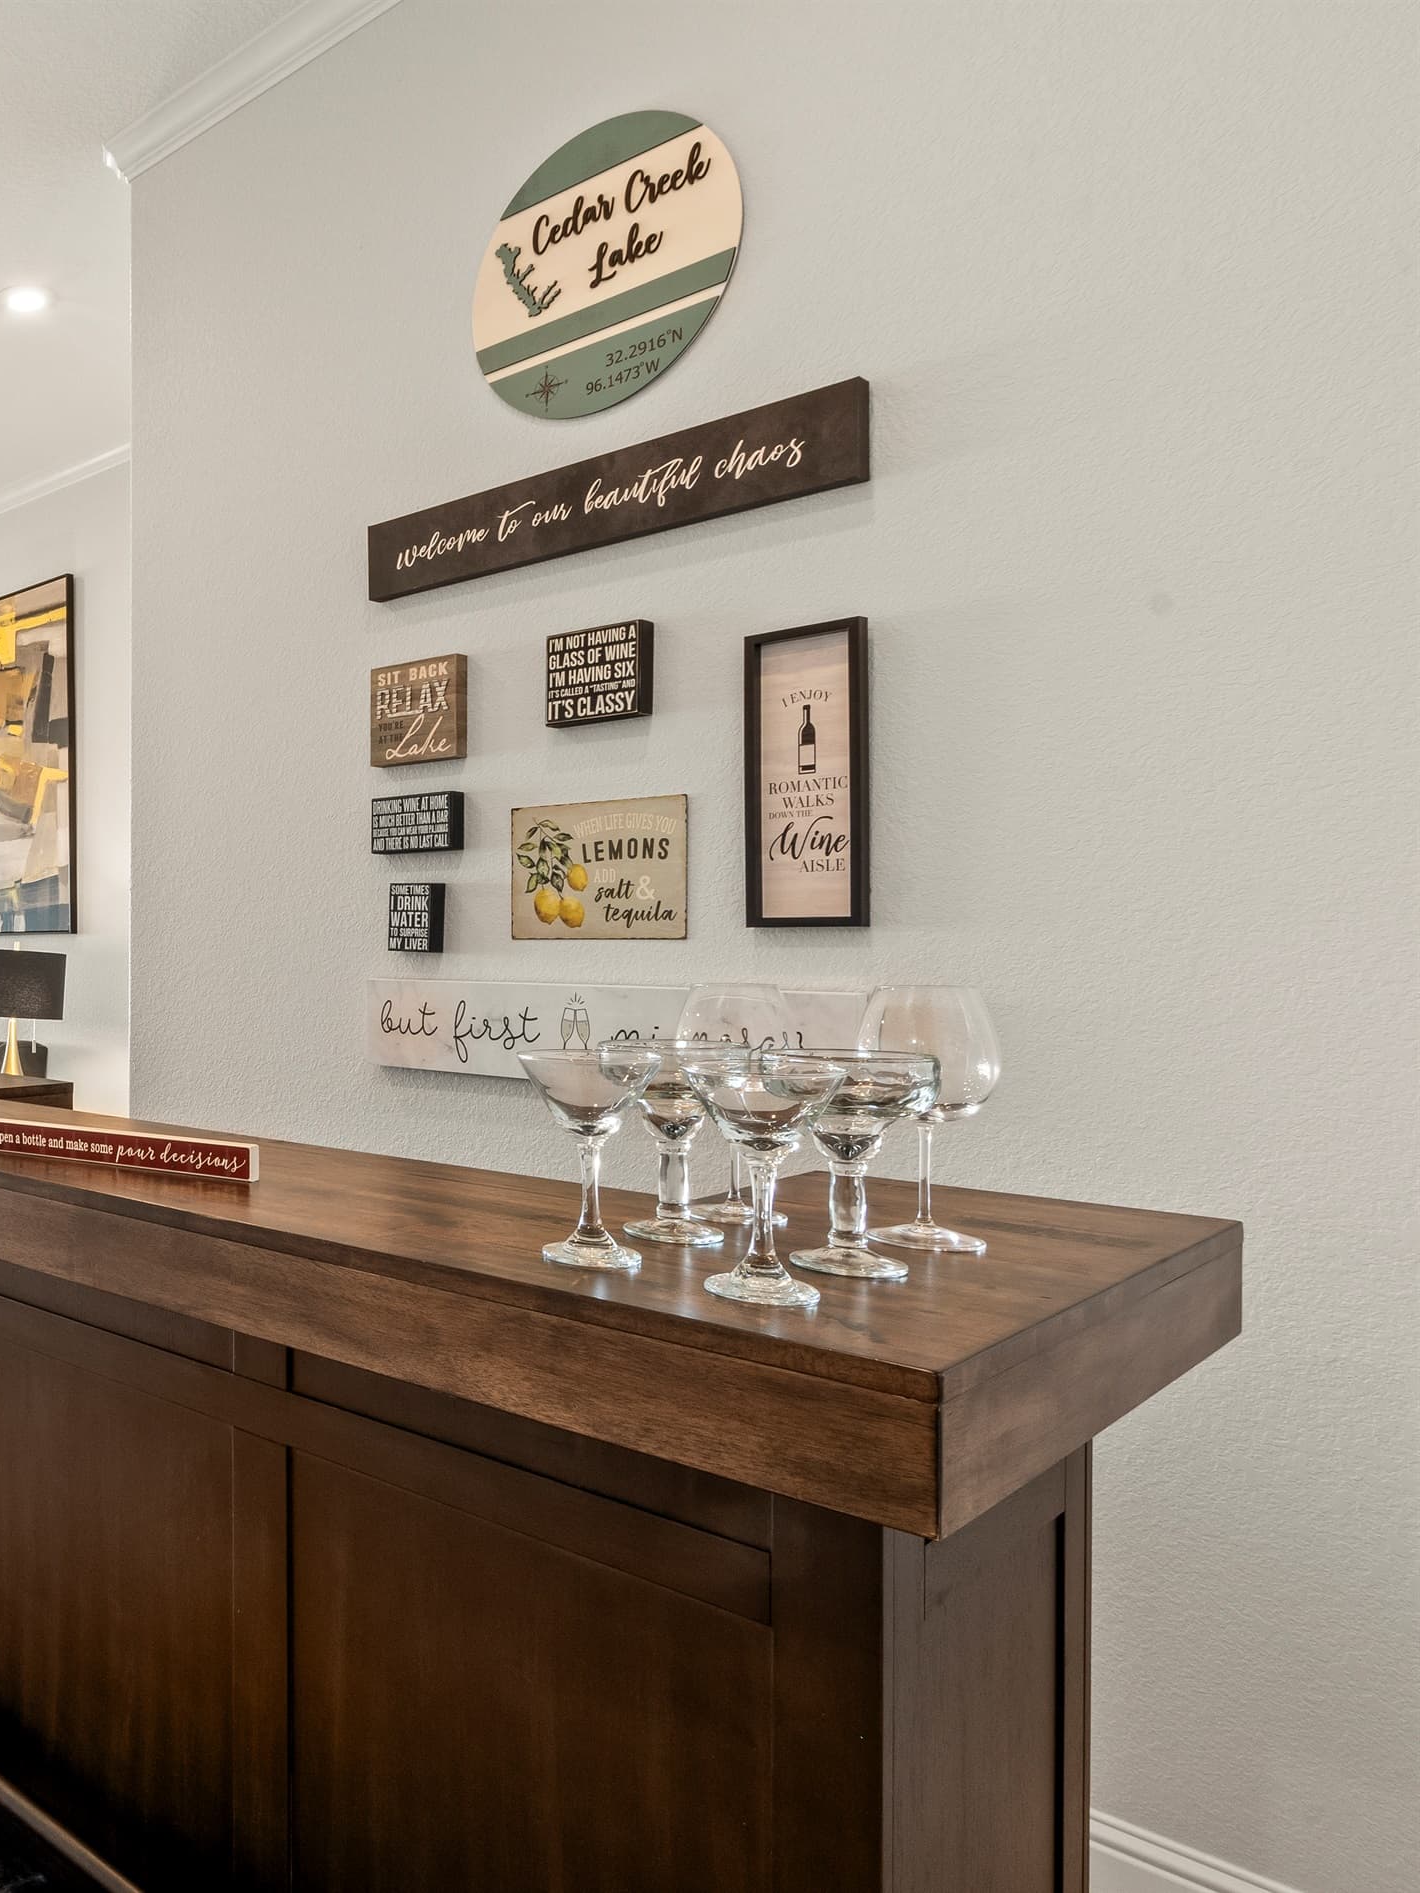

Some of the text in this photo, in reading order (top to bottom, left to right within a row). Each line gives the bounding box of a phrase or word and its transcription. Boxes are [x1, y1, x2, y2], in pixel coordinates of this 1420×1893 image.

[532, 142, 711, 255] Cedar Creek
[588, 223, 664, 289] Lake
[605, 327, 683, 367] 32.2916°N
[586, 358, 661, 395] 96.1473°W
[396, 438, 805, 570] welcome to our beautiful chaos
[549, 624, 636, 653] I'M NOT HAVING A
[549, 641, 636, 670] GLASS OF WINE
[378, 661, 448, 686] SIT BACK
[549, 660, 634, 688] I'M HAVING SIX
[376, 678, 450, 720] RELAX
[548, 690, 560, 699] IT'S
[560, 686, 583, 697] CALLED
[584, 686, 589, 694] A
[622, 678, 636, 688] AND
[782, 689, 833, 708] I ENJOY
[548, 689, 635, 720] IT'S CLASSY
[379, 720, 403, 732] YOU'RE
[386, 713, 451, 760] Lake
[378, 735, 387, 744] AT
[768, 775, 848, 795] ROMANTIC
[373, 794, 448, 815] DRINKING WINE AT HOME
[782, 793, 835, 809] WALKS
[373, 810, 449, 828] IS MUCH BETTER THAN A BAR
[573, 812, 677, 839] WHEN LIFE GIVES YOU
[768, 810, 813, 820] DOWN THE
[373, 833, 449, 851] AND THERE IS NO LAST CALL
[581, 837, 670, 863] LEMONS
[769, 816, 850, 861] Wine
[594, 868, 616, 883] ADD
[799, 858, 845, 873] AISLE
[391, 884, 429, 895] SOMETIMES
[594, 875, 656, 903] salt &
[391, 895, 429, 911] I DRINK
[603, 900, 678, 928] tequila
[391, 911, 429, 927] WATER
[390, 927, 428, 938] TO SURPRISE
[390, 937, 428, 950] MY LIVER
[380, 1000, 438, 1036] but
[453, 1000, 540, 1063] first
[22, 1133, 47, 1147] bottle
[48, 1137, 64, 1149] and
[66, 1139, 89, 1152] make
[90, 1143, 114, 1154] some
[115, 1144, 156, 1163] pour
[160, 1142, 246, 1173] decisions
